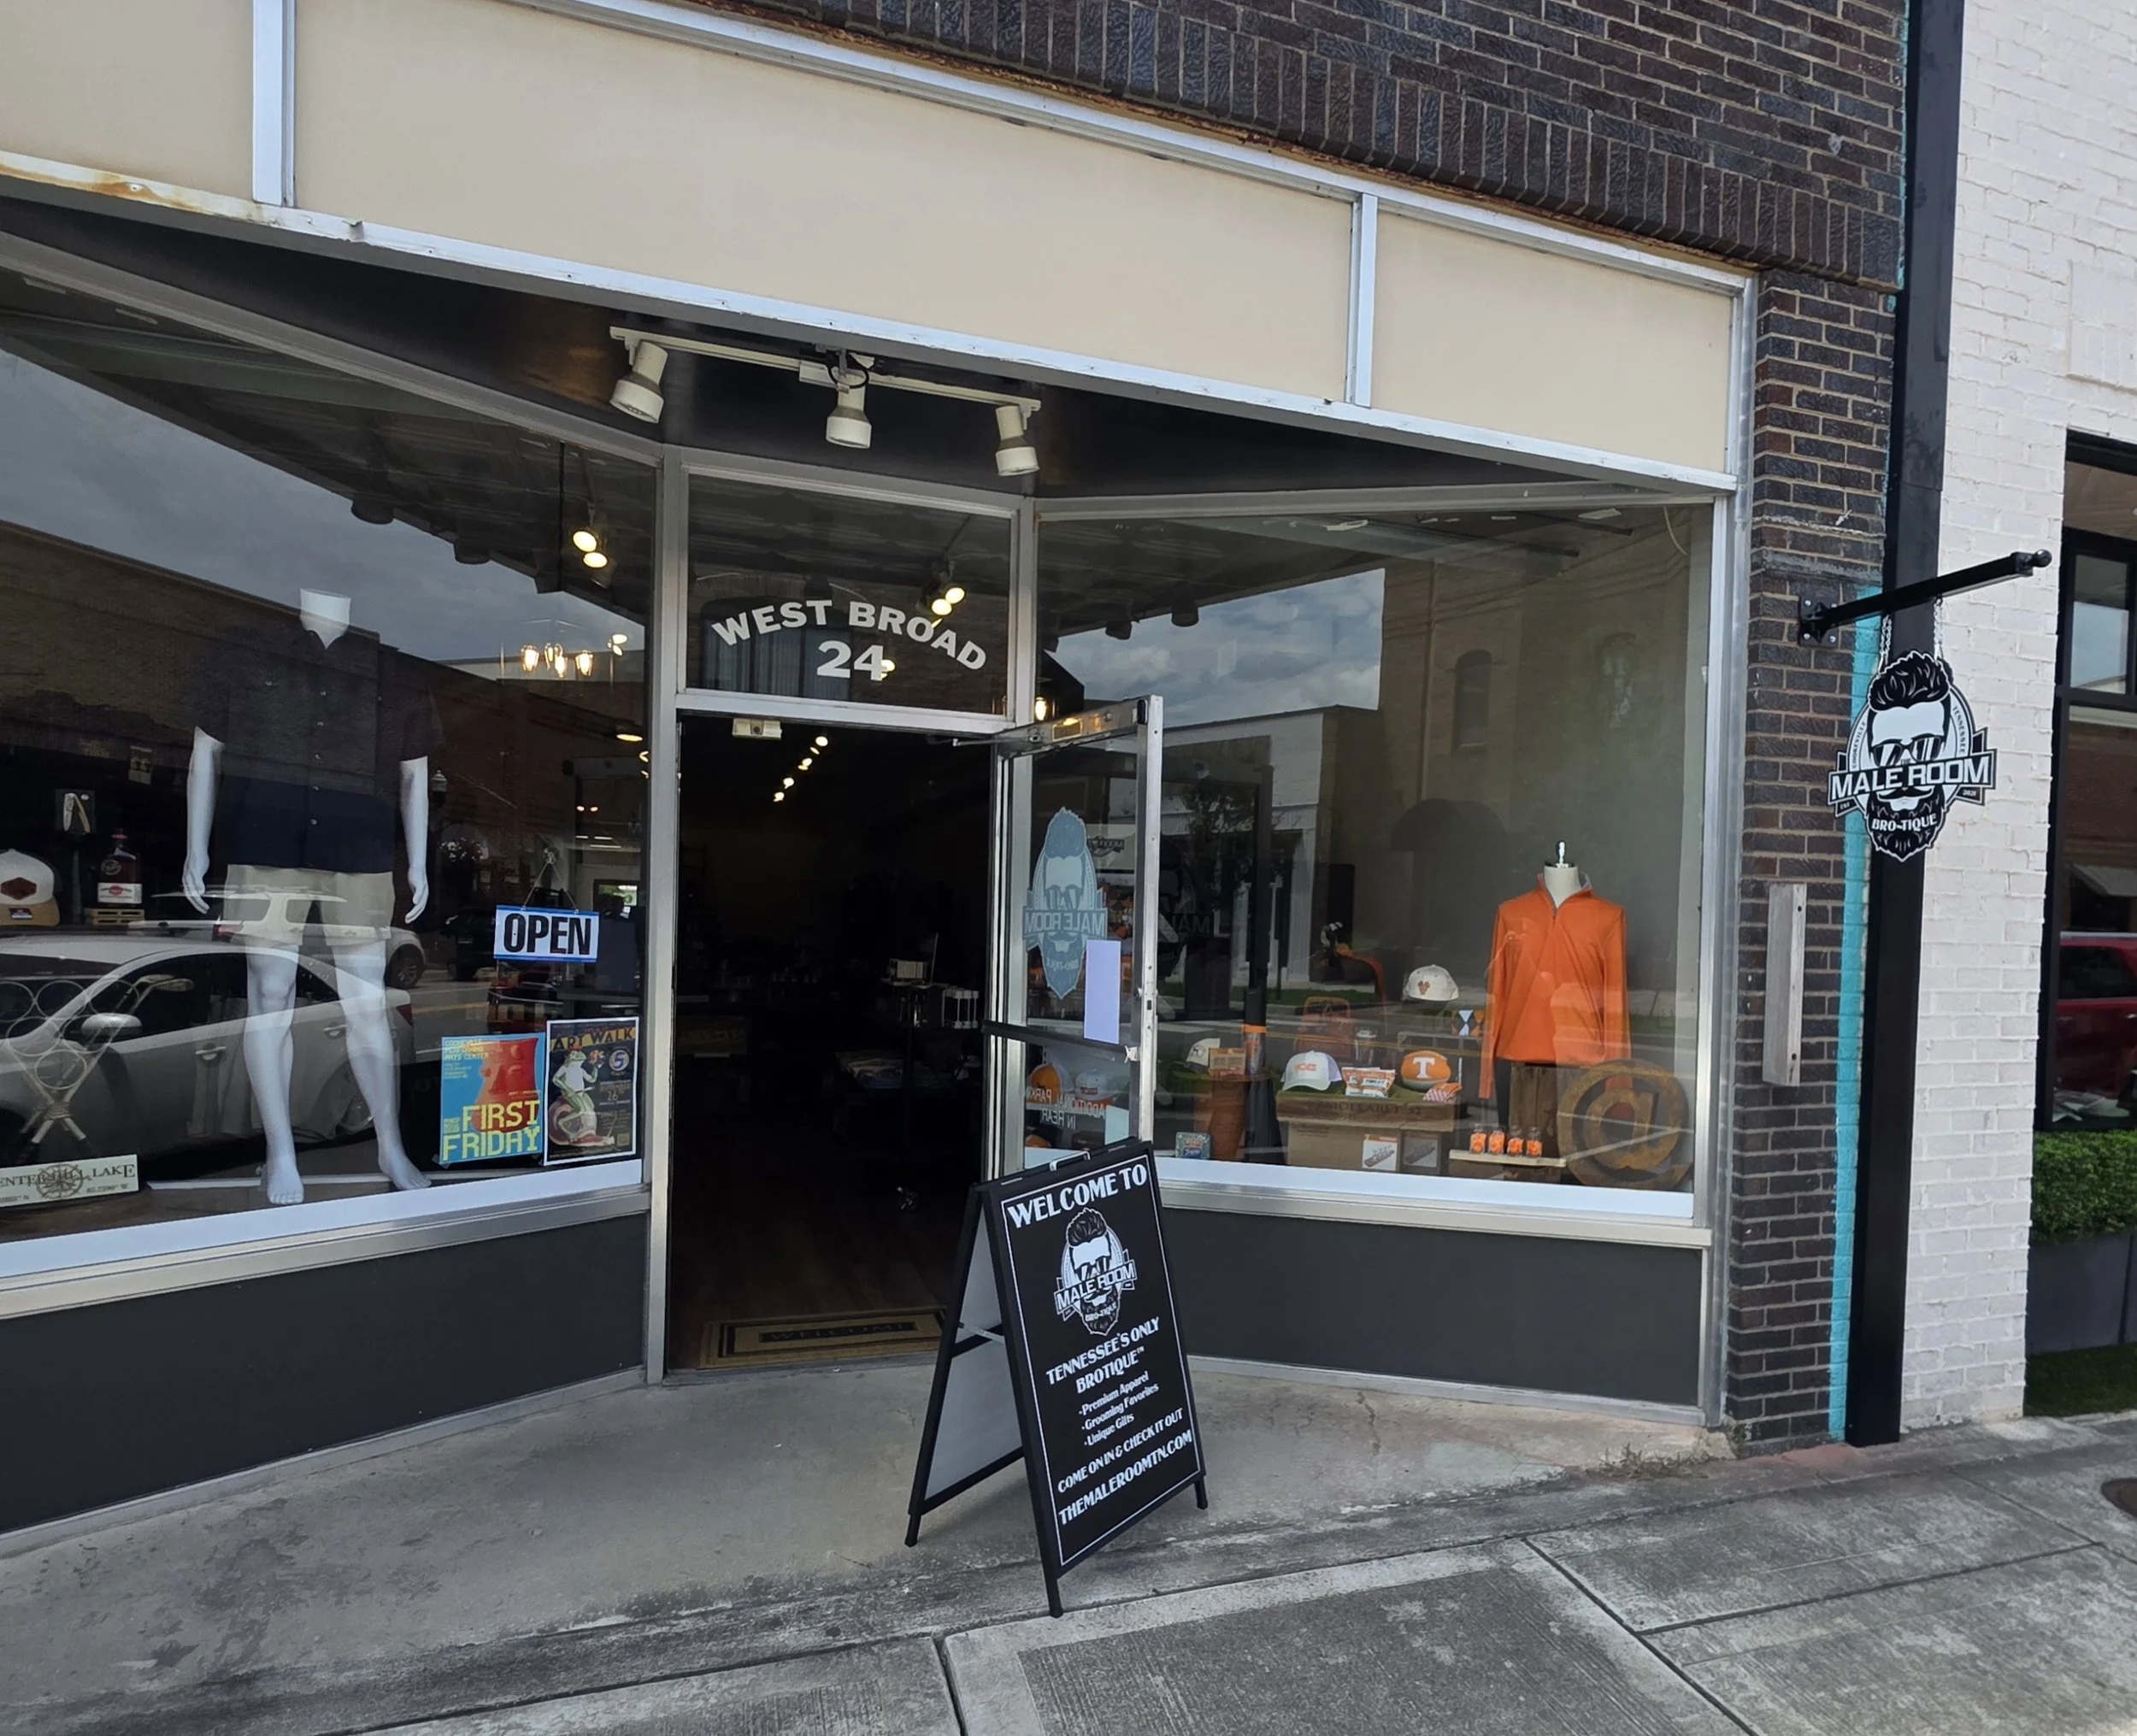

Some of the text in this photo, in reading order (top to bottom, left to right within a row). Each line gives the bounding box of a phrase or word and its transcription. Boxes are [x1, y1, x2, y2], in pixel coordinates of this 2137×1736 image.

[711, 599, 987, 670] WEST BROAD
[816, 640, 885, 682] 24
[1831, 756, 1990, 802] MALE ROOM
[1871, 813, 1938, 833] BRO-TIQUE
[503, 913, 592, 956] OPEN
[552, 1027, 634, 1051] ART WALK
[462, 1100, 540, 1132] FIRST
[443, 1126, 540, 1161] FRIDAY
[92, 1164, 135, 1178] LAKE
[1008, 1163, 1147, 1228] WELCOME TO
[1056, 1278, 1097, 1310] MALE
[1097, 1263, 1135, 1289] ROOM
[1045, 1316, 1160, 1385] TENNESSEE'S ONLY
[1119, 1371, 1149, 1396] Apparel
[1124, 1383, 1159, 1409] Favorites
[1115, 1412, 1135, 1428] Gifts
[1057, 1408, 1183, 1493] COME ON IN & CHECK IT OUT
[1058, 1428, 1192, 1526] THEMALEROOMTN.COM
